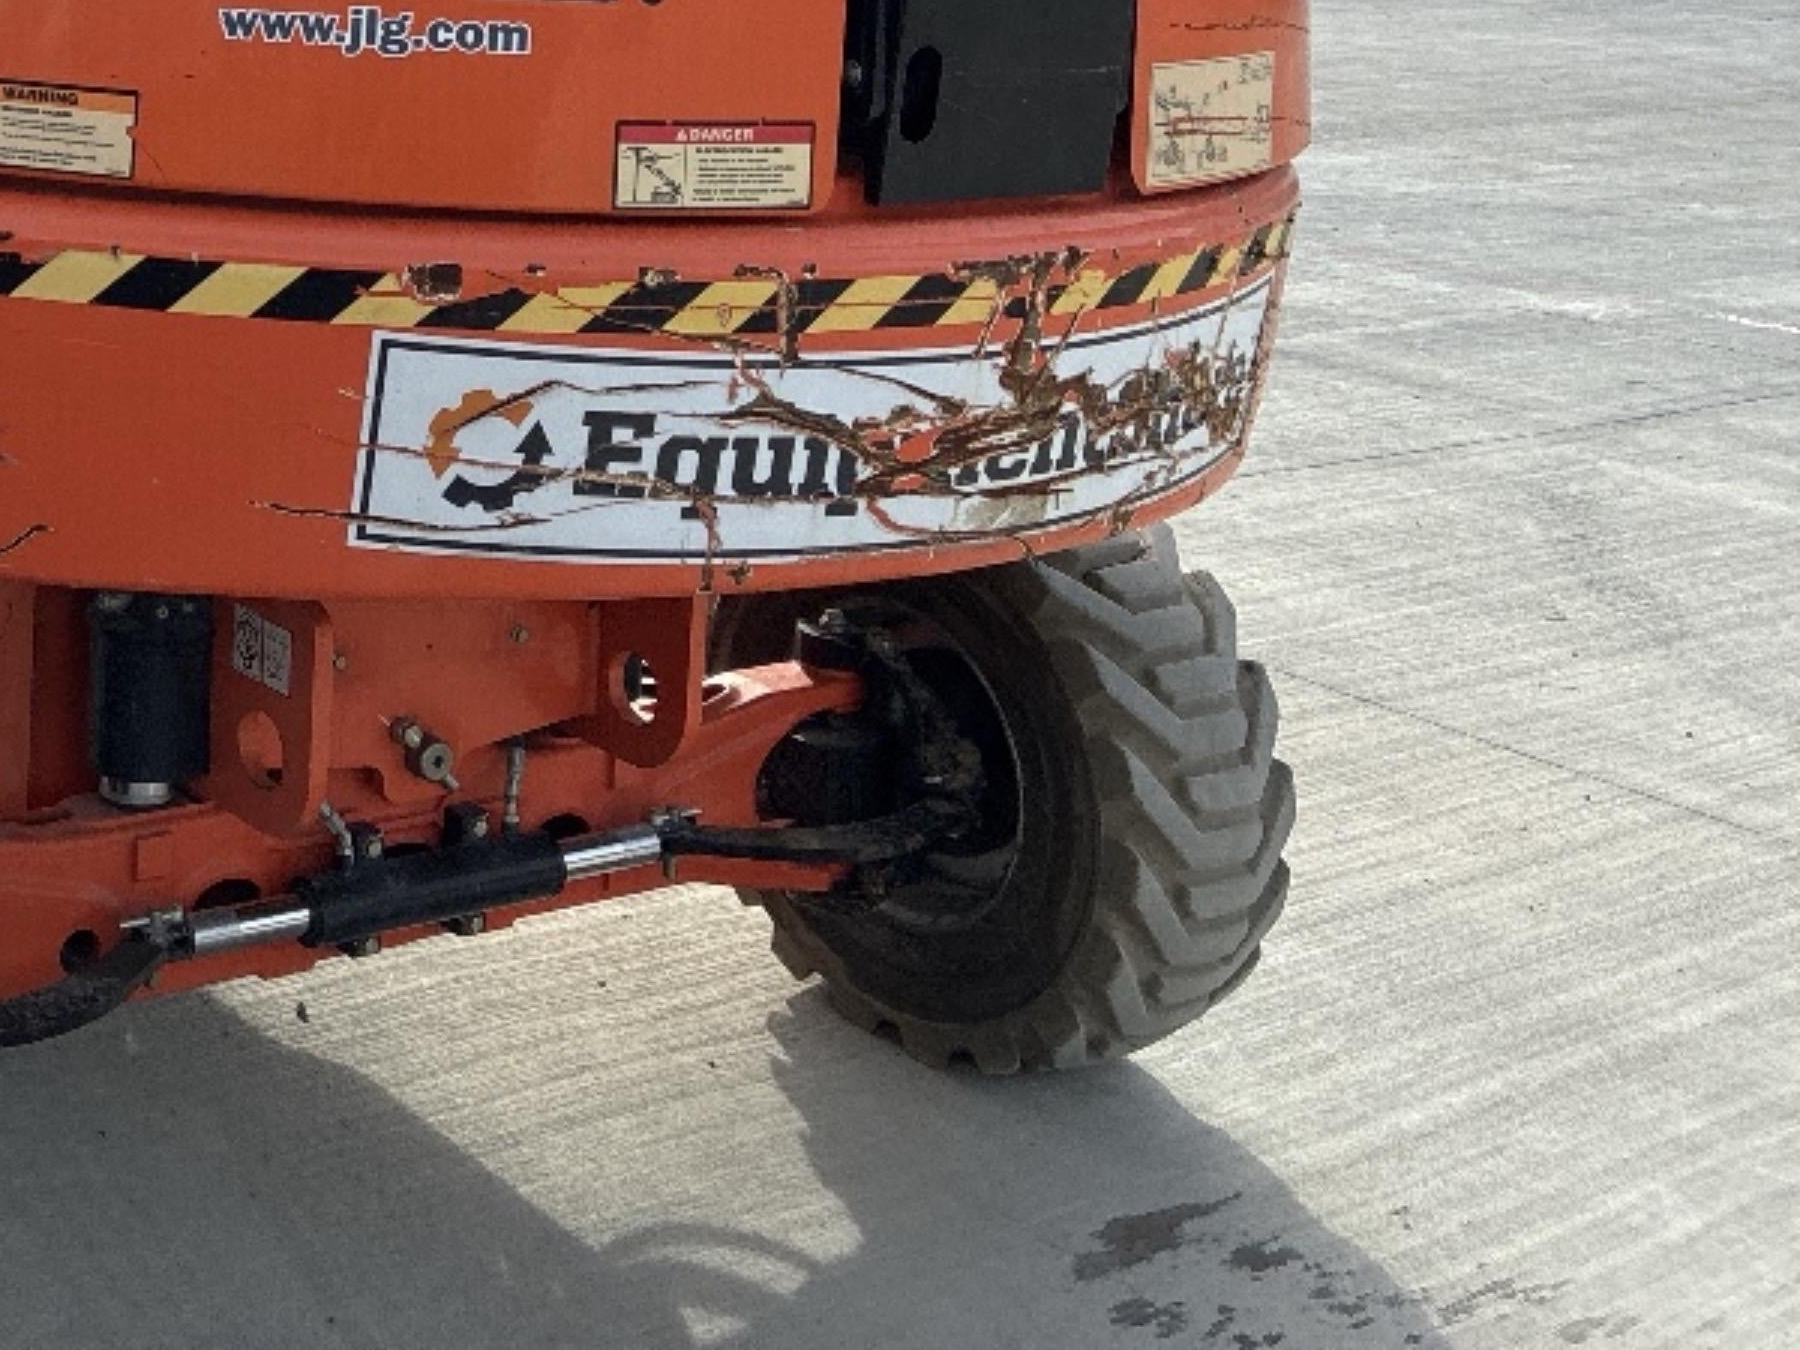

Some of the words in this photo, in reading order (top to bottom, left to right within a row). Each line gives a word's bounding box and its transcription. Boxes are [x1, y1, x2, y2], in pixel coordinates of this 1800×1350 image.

[219, 6, 532, 55] www.jlg.com
[2, 85, 80, 106] WARNING
[689, 127, 755, 142] DANGER
